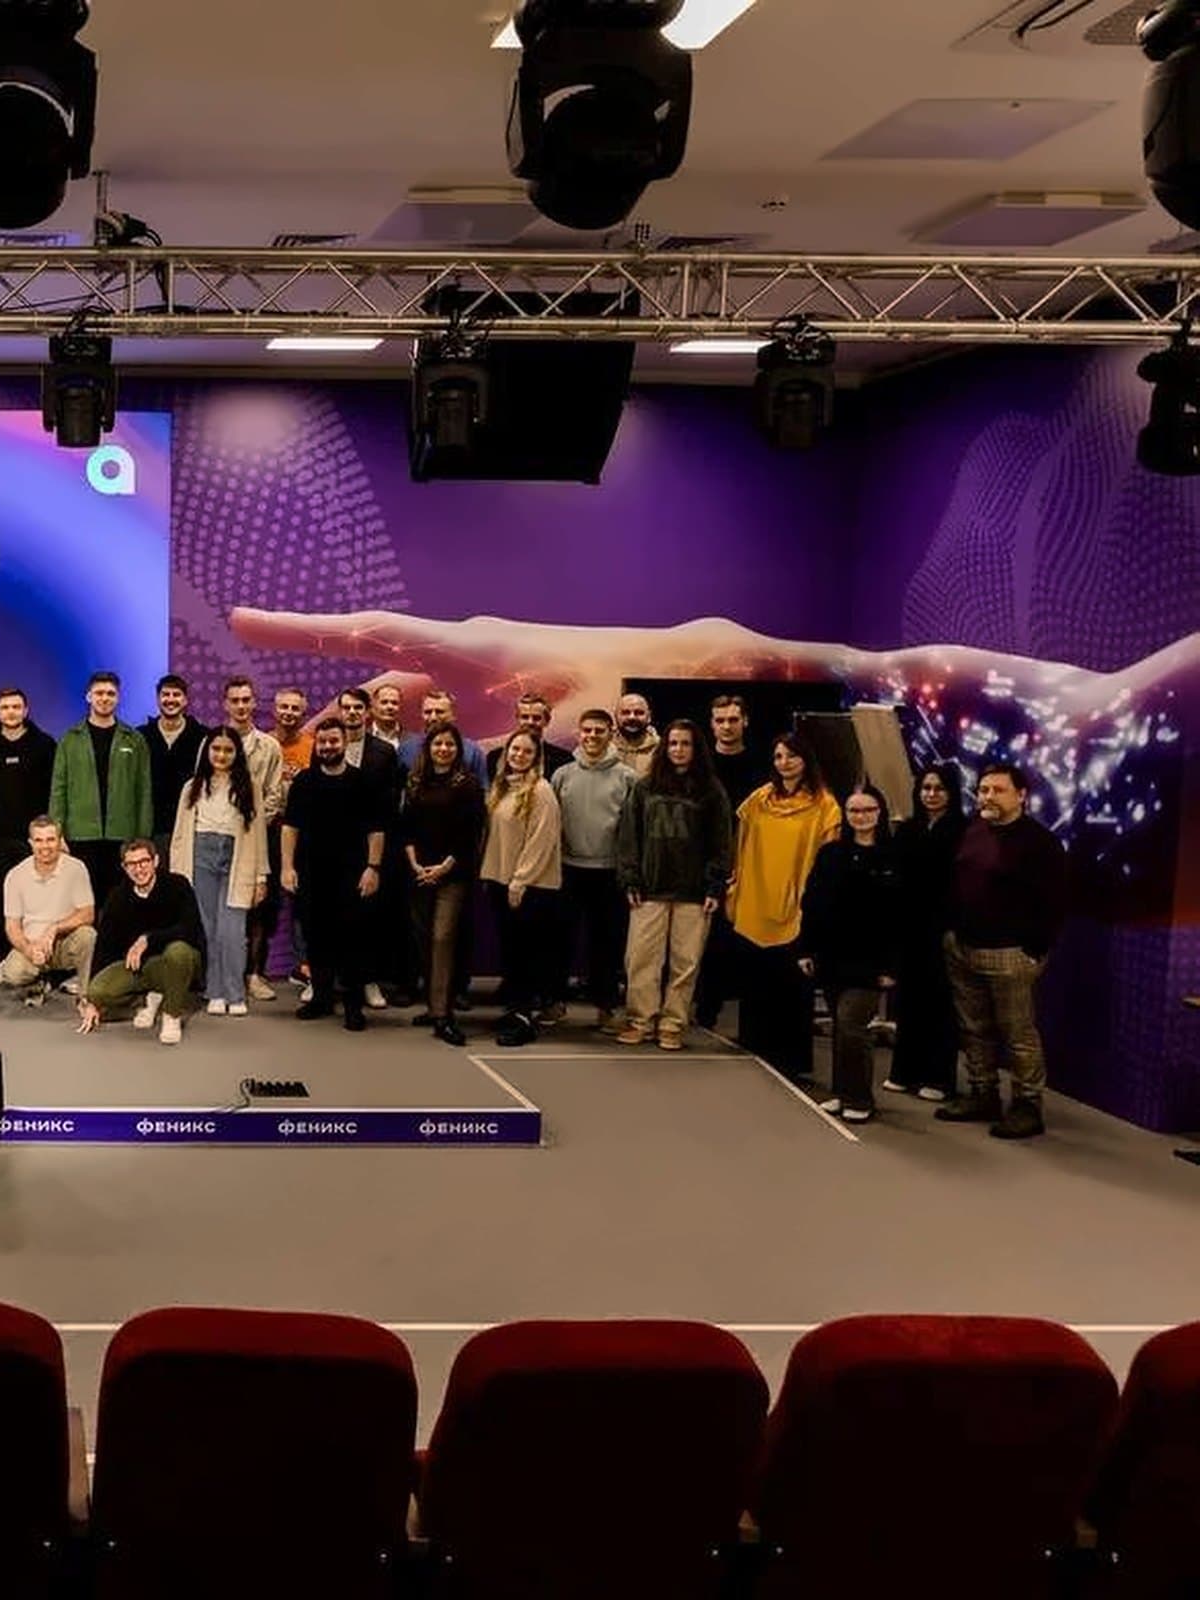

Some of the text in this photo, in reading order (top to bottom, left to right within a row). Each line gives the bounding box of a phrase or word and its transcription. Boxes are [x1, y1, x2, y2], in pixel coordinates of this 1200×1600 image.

[137, 1118, 215, 1135] ФЕНИКС
[278, 1119, 356, 1135] ФЕНИКС
[419, 1120, 497, 1135] ФЕНИКС
